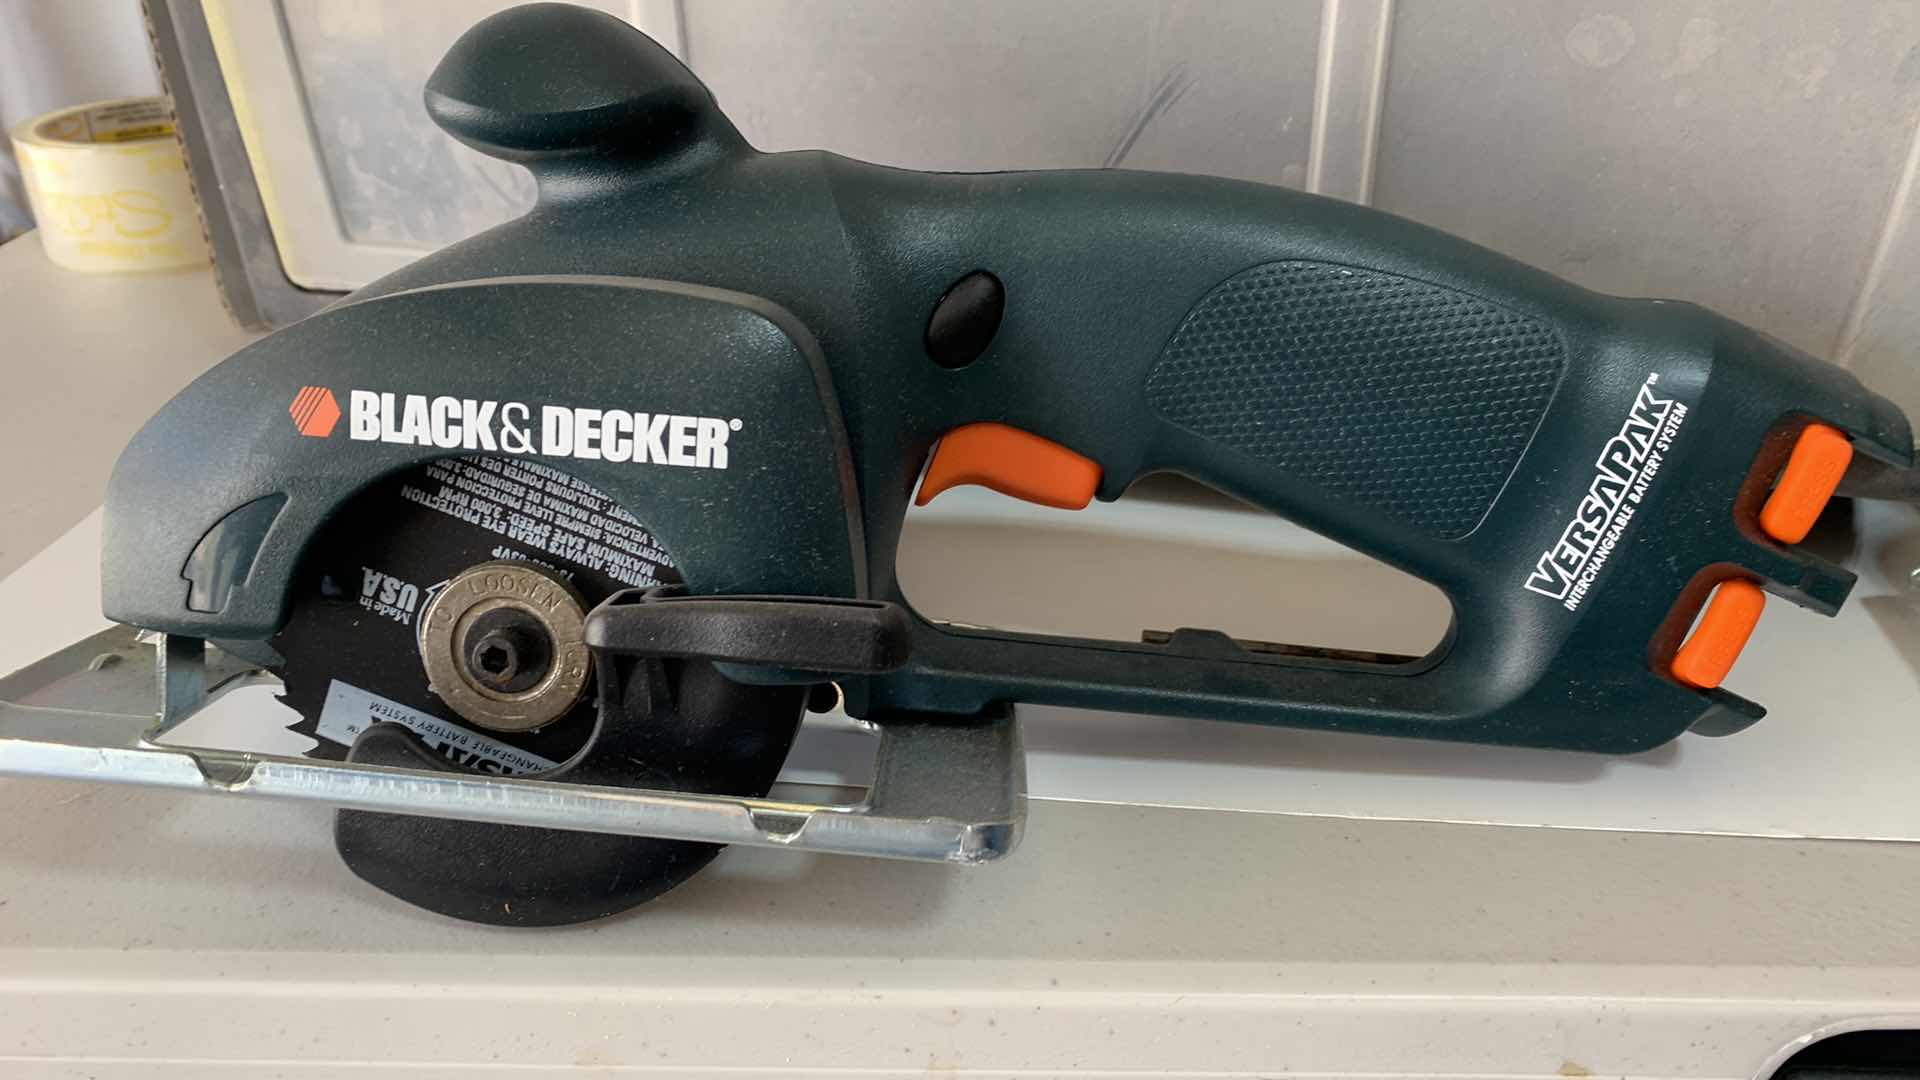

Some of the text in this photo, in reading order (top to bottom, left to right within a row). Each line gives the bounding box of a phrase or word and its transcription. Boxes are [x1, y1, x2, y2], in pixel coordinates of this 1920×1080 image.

[427, 466, 455, 485] PARA
[502, 465, 544, 489] PORTER
[401, 485, 482, 525] PROTECTION
[438, 486, 470, 507] RPM
[455, 476, 523, 510] PROTECCION
[526, 489, 542, 504] DE
[544, 481, 601, 511] TOUJOURS
[1564, 401, 1689, 611] INTERCHANGEABLE BATTERY SYSTEM
[470, 498, 503, 519] 3,000
[522, 501, 555, 522] LLEVE
[543, 495, 590, 522] MAXIMA
[481, 513, 507, 534] EYE
[505, 511, 552, 538] SPEED:
[507, 524, 546, 550] WEAR
[554, 513, 602, 540] SIEMPRE
[590, 514, 648, 544] VELOCIDAD
[551, 528, 586, 550] SAFE
[547, 539, 605, 570] ALWAYS
[586, 541, 655, 577] MAXIMUM
[468, 573, 562, 613] LOOSEN
[360, 595, 412, 625] Made in
